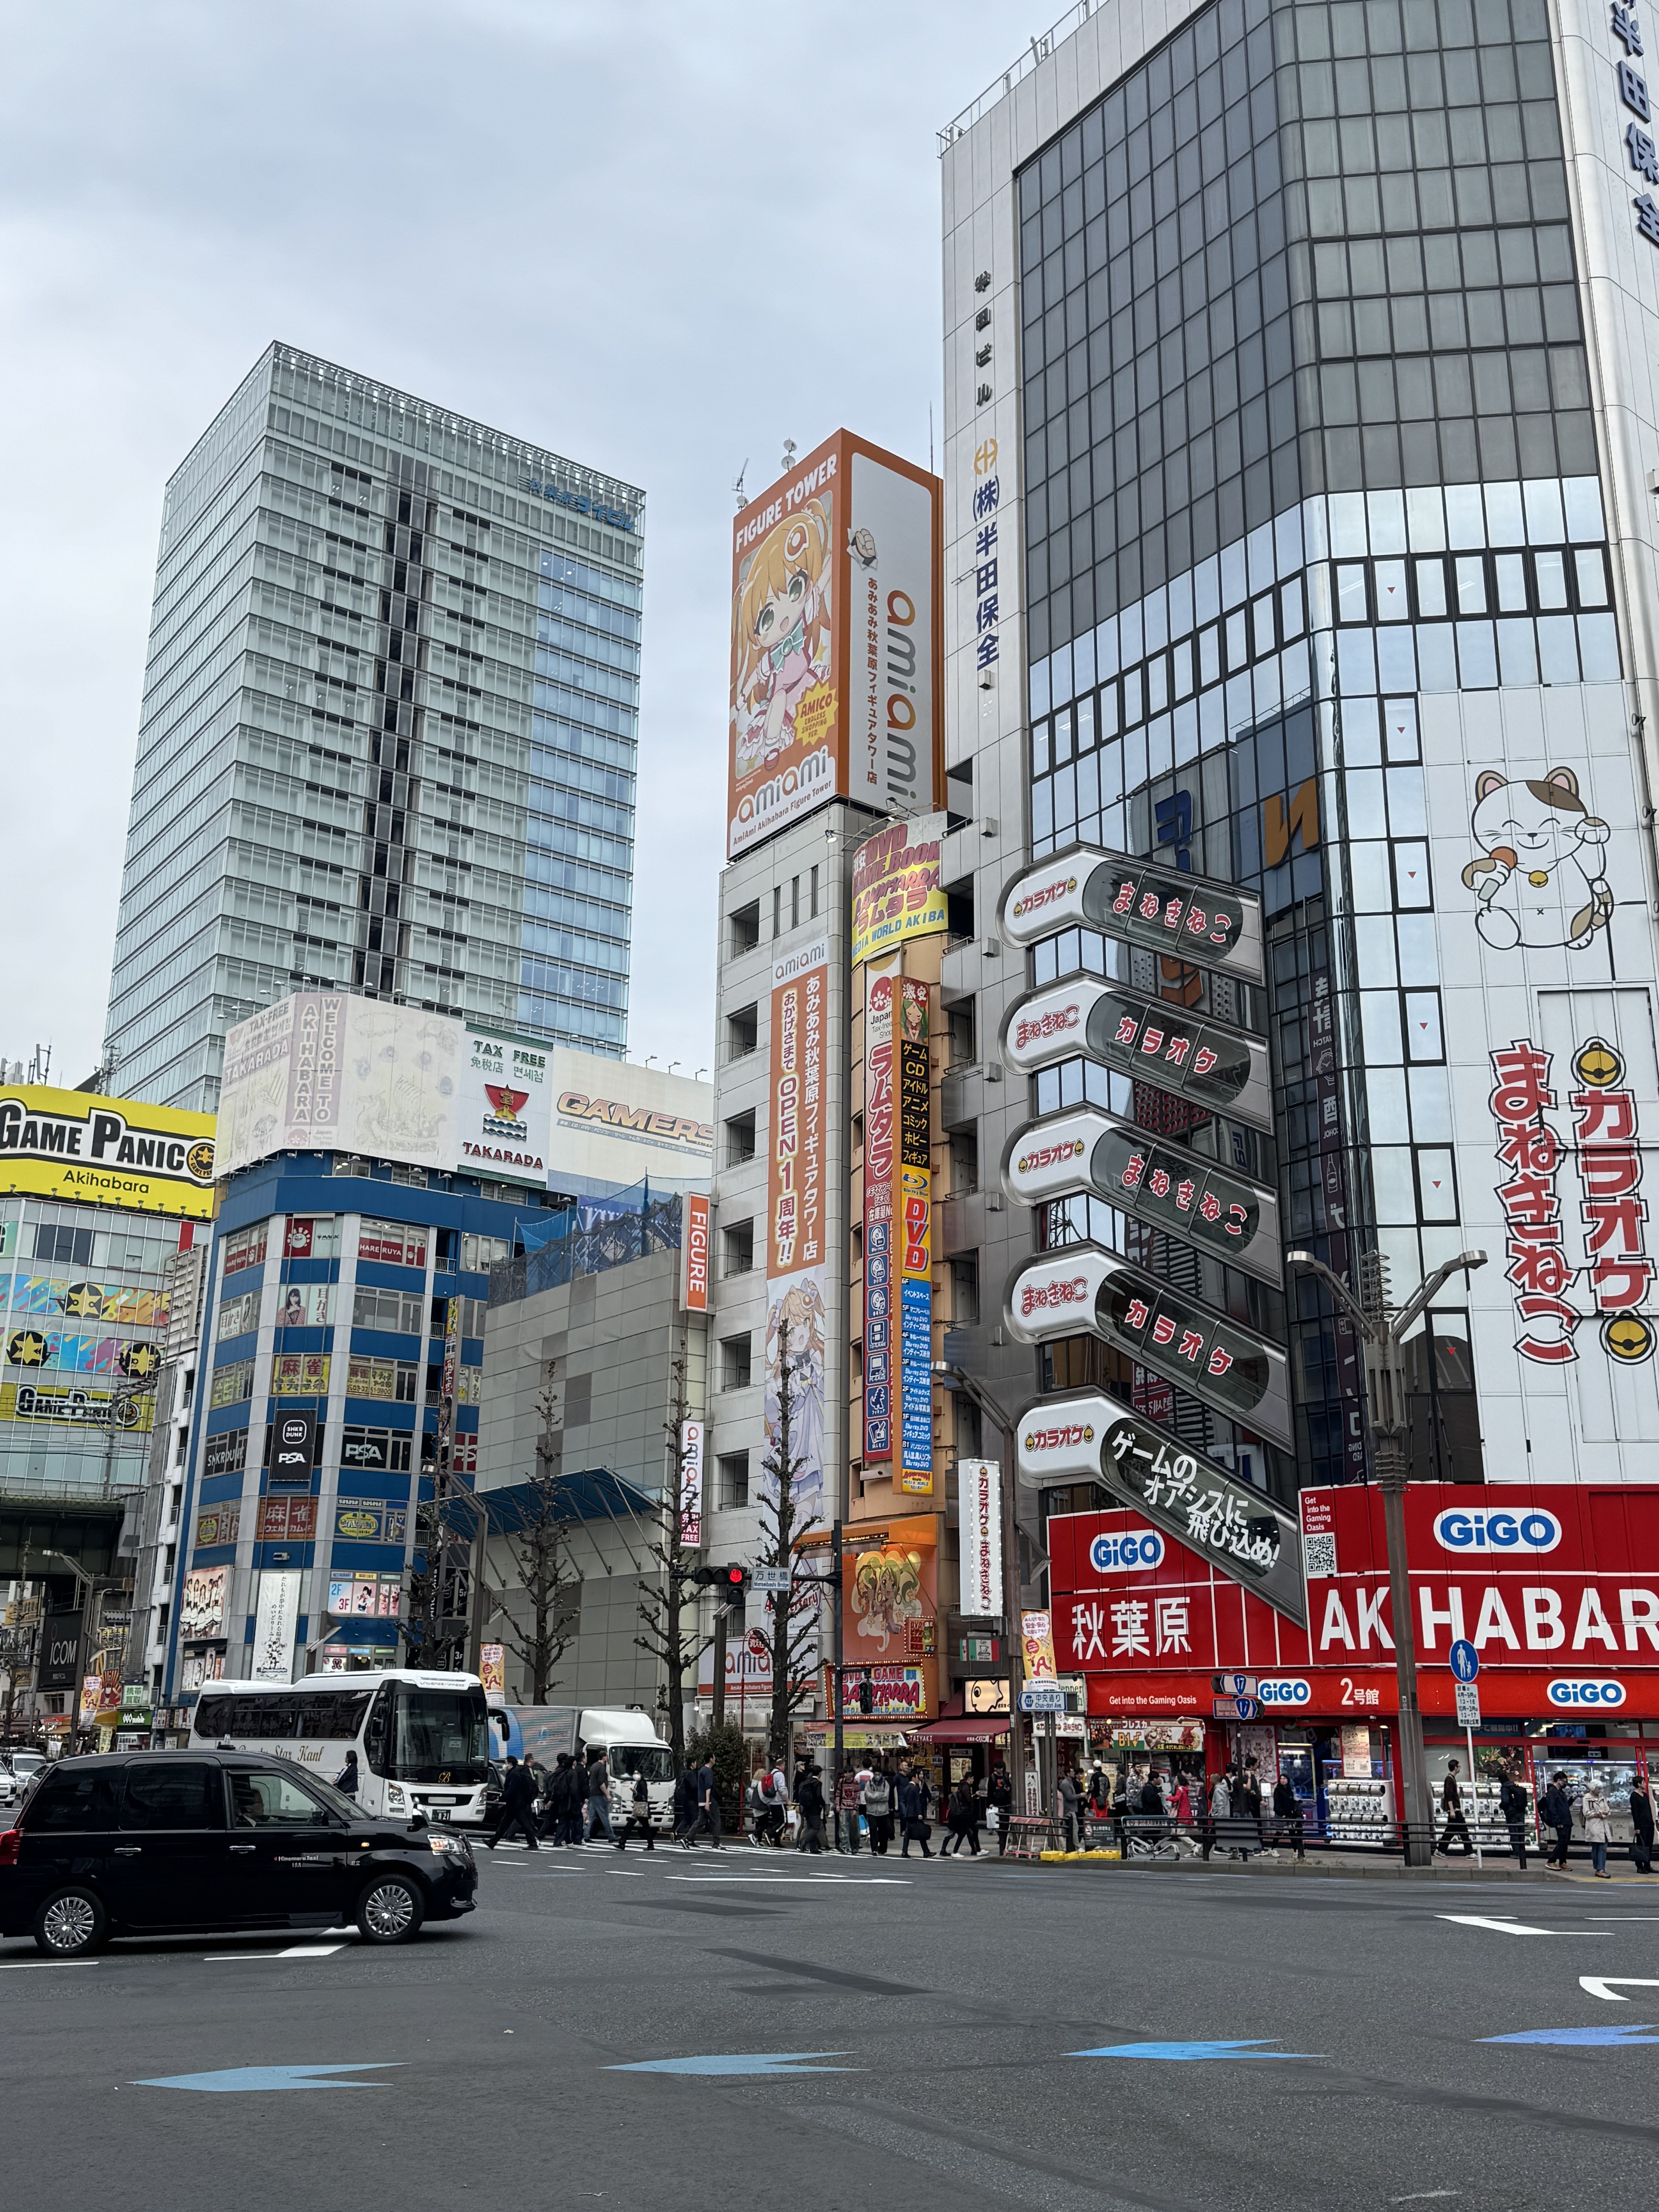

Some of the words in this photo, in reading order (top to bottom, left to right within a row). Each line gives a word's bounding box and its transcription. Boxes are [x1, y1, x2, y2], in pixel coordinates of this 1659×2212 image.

[735, 497, 782, 553] FIGURE
[785, 453, 836, 511] TOWER
[867, 577, 878, 785] あみあみ秋葉原フィギュアタワー店
[887, 590, 917, 799] amiami
[800, 693, 832, 718] AMICO
[805, 711, 826, 726] ENDLESS
[802, 717, 827, 734] SHOPPING
[738, 748, 828, 823] amiami
[757, 806, 789, 832] Akihabara
[790, 793, 811, 814] Figure
[812, 780, 832, 797] Tower
[866, 824, 908, 865] DVD
[1022, 879, 1068, 912] カラオケ
[872, 919, 902, 942] WORLD
[905, 909, 945, 928] AKIBA
[1113, 882, 1231, 943] まねきねこ
[775, 943, 824, 979] amiami
[903, 983, 927, 1001] 激安
[783, 992, 796, 1069] おかげさまで
[1016, 1004, 1080, 1050] まねきねこ
[318, 997, 342, 1089] WELCOME
[474, 1040, 503, 1058] TAX
[513, 1049, 546, 1068] FREE
[903, 1043, 927, 1060] ゲーム
[1115, 1016, 1218, 1075] カラオケ
[226, 1039, 288, 1083] TAKARADA
[292, 1004, 319, 1122] AKIHABARA
[471, 1056, 503, 1074] 免税店
[514, 1066, 544, 1083] 면세점
[906, 1061, 925, 1076] CD
[903, 1079, 928, 1094] アイドル
[314, 1094, 334, 1121] TO
[558, 1091, 713, 1144] GAMERS
[779, 1078, 797, 1157] OPEN
[869, 1042, 893, 1177] ラムタラ
[903, 1096, 929, 1112] アニメ
[803, 975, 821, 1261] あみあみ秋葉原フィギュアタワー店
[903, 1114, 927, 1129] コミック
[0, 1104, 81, 1156] GAME
[91, 1114, 186, 1171] PANIC
[904, 1132, 927, 1145] ホビー
[462, 1141, 543, 1170] TAKARADA
[903, 1150, 927, 1165] フィギュア
[1027, 1140, 1076, 1172] カラオケ
[63, 1170, 149, 1194] Akihabara
[1122, 1153, 1248, 1235] まねきねこ
[1489, 1039, 1582, 1365] まねきねこ
[1570, 1089, 1656, 1312] カラオケ
[905, 1197, 929, 1272] DVD
[689, 1211, 706, 1294] FIGURE
[1021, 1276, 1088, 1317] まねきねこ
[1124, 1299, 1234, 1376] カラオケ
[281, 1358, 325, 1377] 麻雀
[1034, 1423, 1084, 1448] カラオケ
[278, 1452, 305, 1463] PSA
[345, 1443, 385, 1461] PSA
[455, 1444, 477, 1462] PS
[1111, 1429, 1197, 1486] ゲームの
[266, 1505, 311, 1522] 麻雀
[979, 1477, 989, 1527] カラオケ
[1142, 1475, 1249, 1527] オアシスに
[1305, 1496, 1316, 1505] Get
[1307, 1505, 1319, 1513] into
[1319, 1504, 1330, 1513] the
[1306, 1515, 1331, 1523] Gaming
[1440, 1514, 1555, 1546] GiGO
[681, 1534, 699, 1542] FREE
[1093, 1535, 1161, 1568] GiGO
[1187, 1512, 1281, 1569] 飛び込め!
[756, 1570, 788, 1580] 万世橋
[979, 1540, 991, 1611] まねきねこ
[331, 1584, 342, 1595] 2F
[459, 1588, 467, 1597] 5F
[339, 1598, 350, 1610] 3F
[1071, 1595, 1192, 1660] 秋葉原
[1319, 1587, 1659, 1651] AKHABAR
[49, 1640, 77, 1665] iCOM
[455, 1651, 463, 1660] 3F
[725, 1650, 771, 1673] amia
[874, 1666, 903, 1682] GAME
[1237, 1678, 1245, 1690] 17
[126, 1687, 142, 1696] 携帯
[1036, 1694, 1060, 1702] 中央通り
[1109, 1695, 1121, 1705] Get
[1121, 1695, 1135, 1705] into
[1136, 1695, 1147, 1704] the
[1149, 1695, 1176, 1706] Gaming
[1177, 1695, 1196, 1704] Oasis
[1260, 1682, 1309, 1701] GiGO
[1340, 1678, 1379, 1705] 2号館
[1551, 1683, 1622, 1703] GiGO
[1122, 1720, 1147, 1729] フレスカ
[1118, 1732, 1130, 1747] B1
